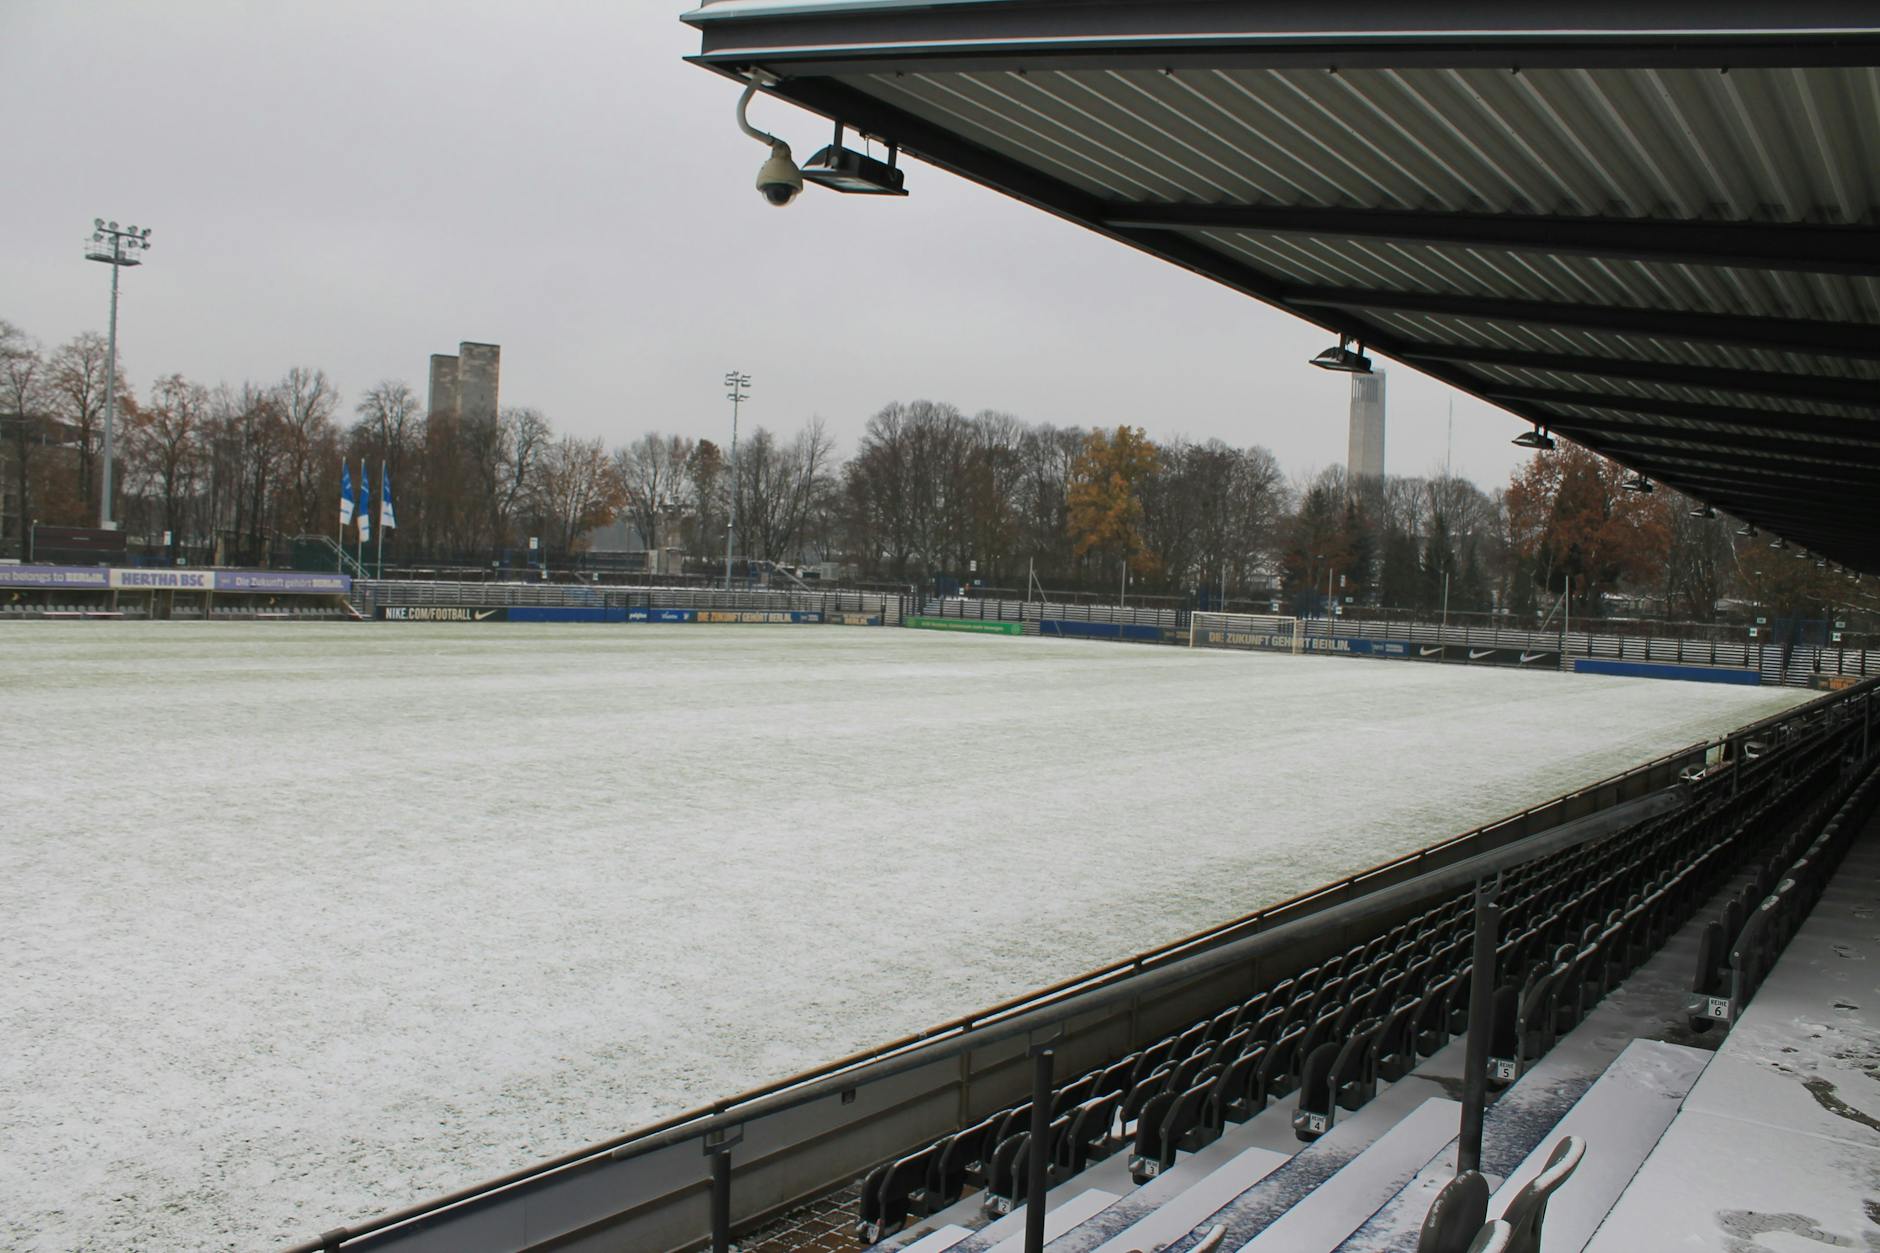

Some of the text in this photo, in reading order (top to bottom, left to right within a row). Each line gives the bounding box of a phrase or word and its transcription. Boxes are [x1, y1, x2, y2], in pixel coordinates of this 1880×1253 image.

[121, 572, 204, 586] HERTHA BSC
[385, 607, 471, 620] NIKE.COM/FOOTBALL
[1226, 632, 1270, 645] ZUKUNFT
[1312, 638, 1350, 651] BERLIN.
[1710, 999, 1727, 1007] REIHE
[1715, 1006, 1722, 1016] 6
[1503, 1068, 1509, 1077] 5
[1314, 1122, 1320, 1130] 4
